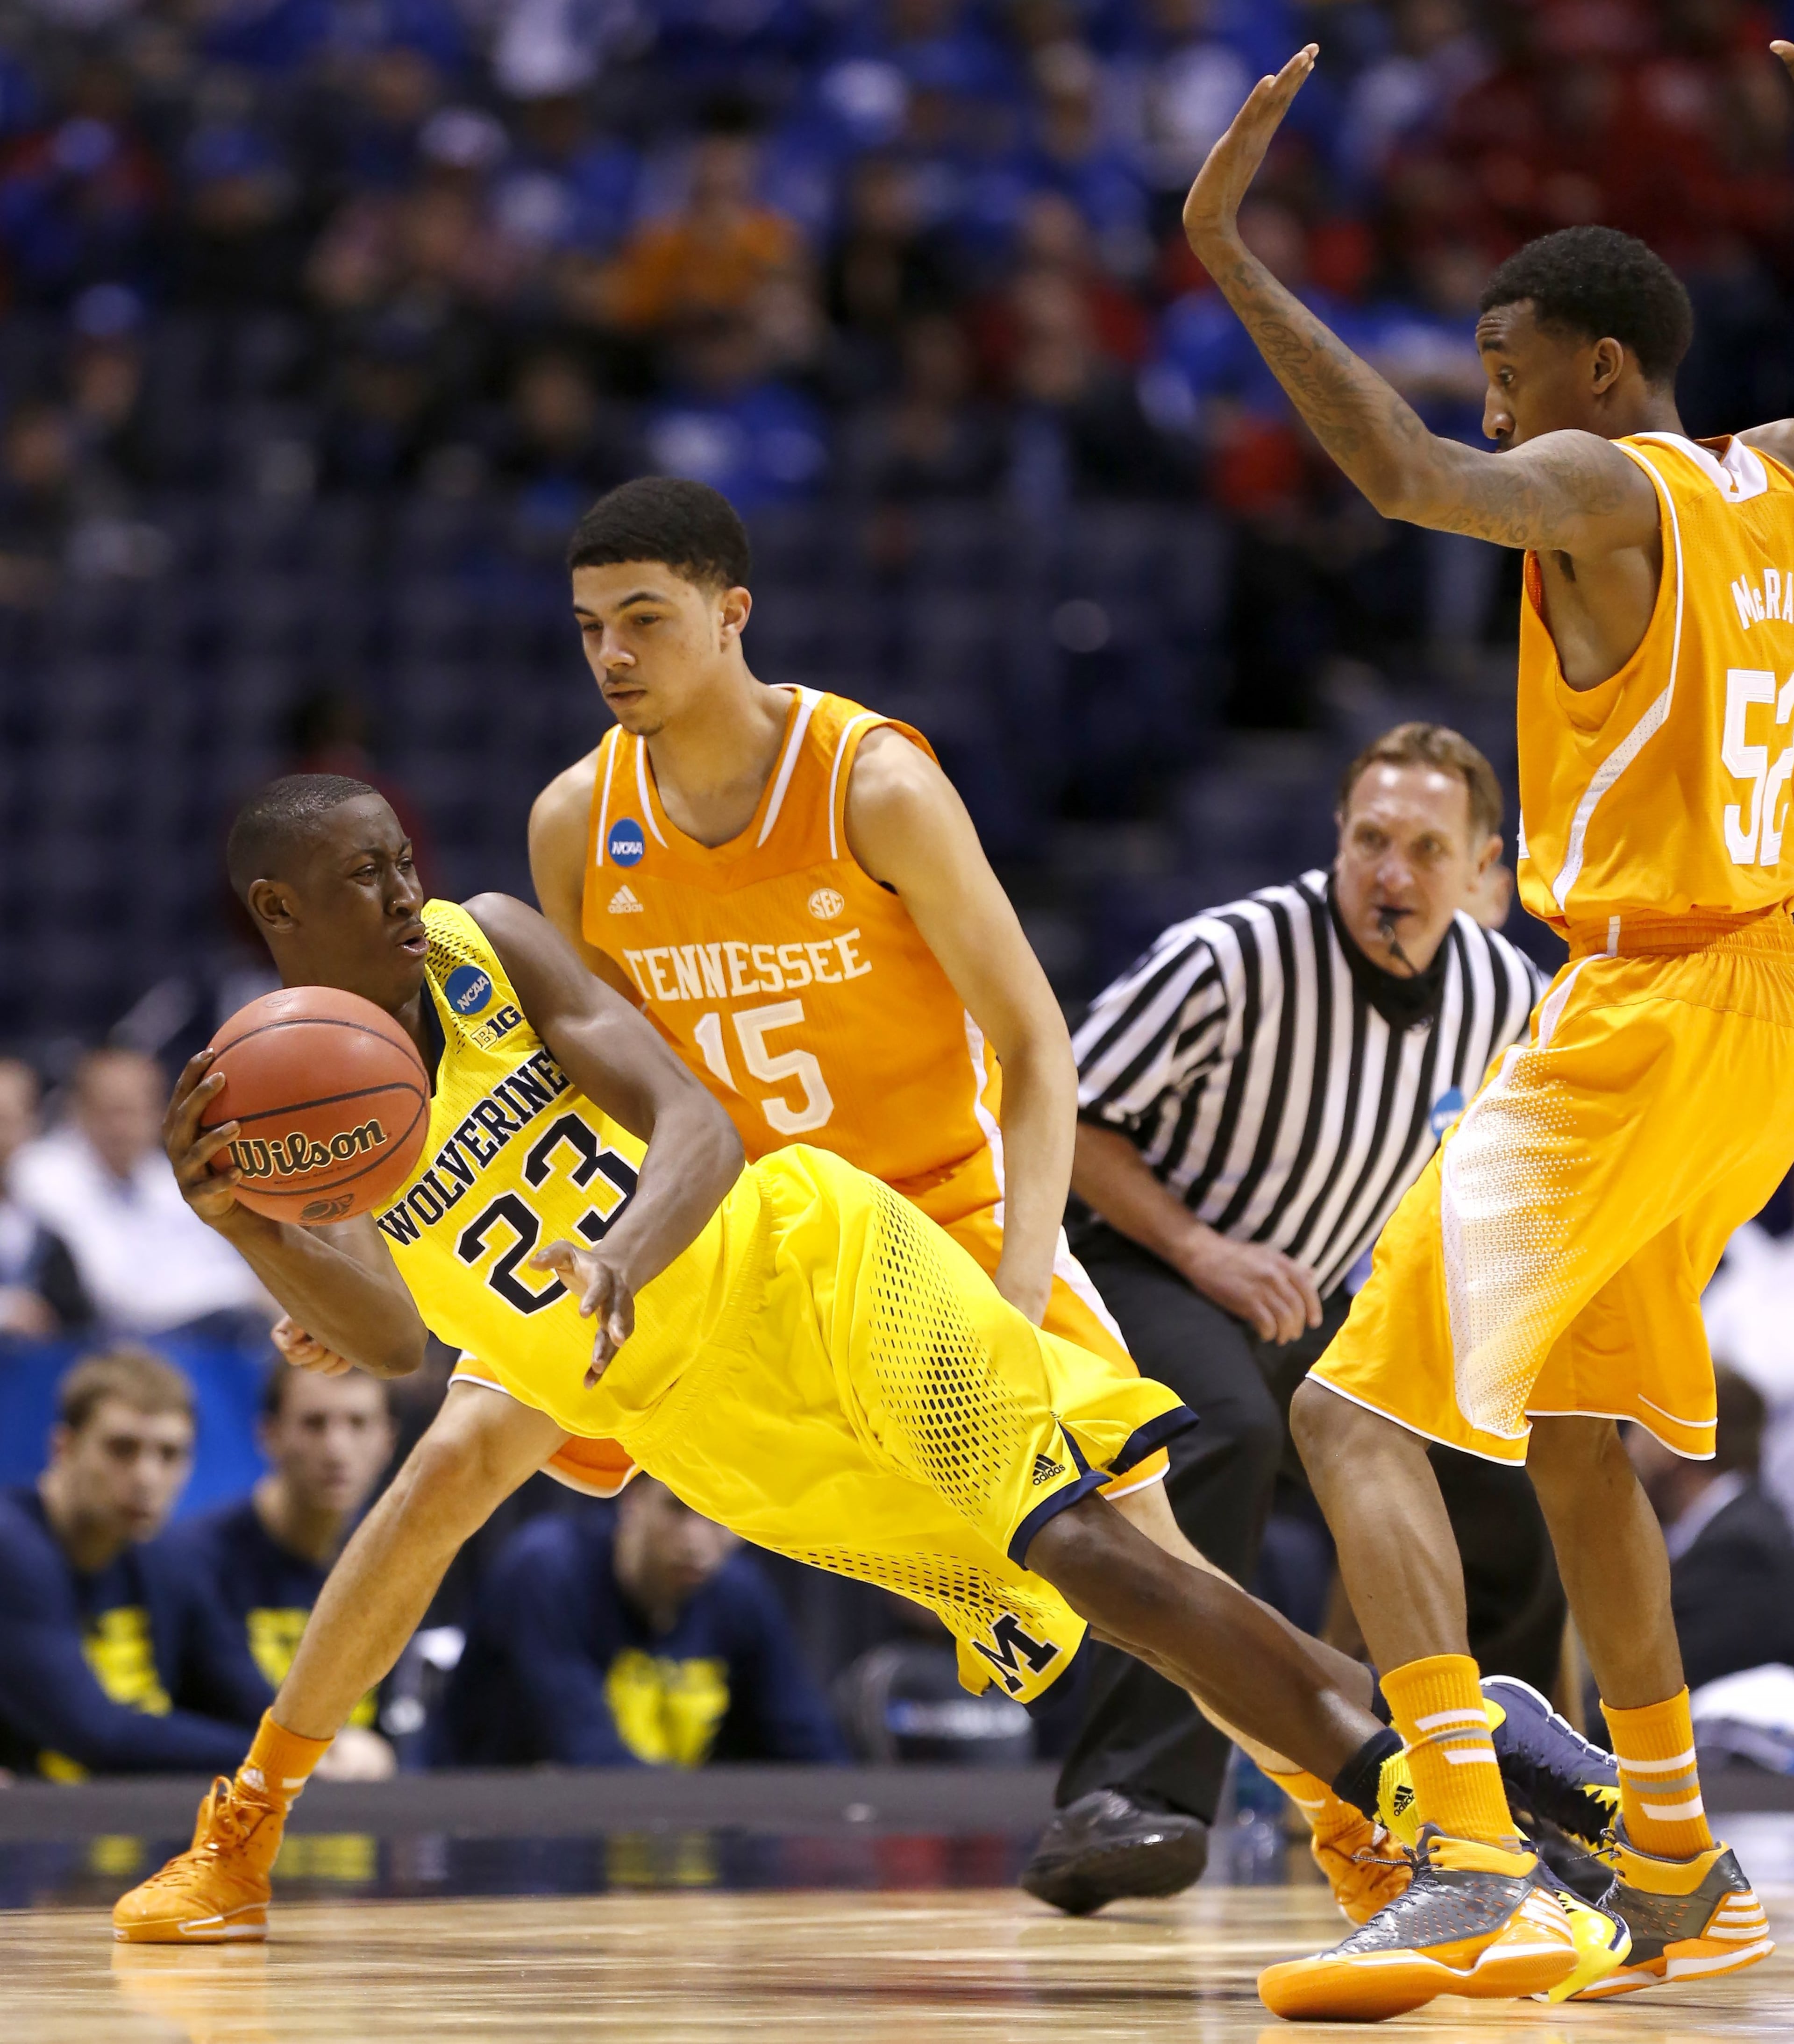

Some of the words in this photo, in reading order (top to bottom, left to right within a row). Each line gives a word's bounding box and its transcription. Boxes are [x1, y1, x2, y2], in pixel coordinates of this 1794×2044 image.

[612, 841, 643, 855] NCAA
[811, 891, 842, 917] SEC
[456, 974, 490, 1011] NCAA
[622, 928, 872, 1001] TENNESSEE
[693, 998, 834, 1136] 15
[228, 1119, 387, 1178] Wilson
[376, 1045, 574, 1246] WOLVERINE
[453, 1110, 639, 1318] 23
[1032, 1464, 1066, 1485] adidas
[971, 1612, 1063, 1695] M
